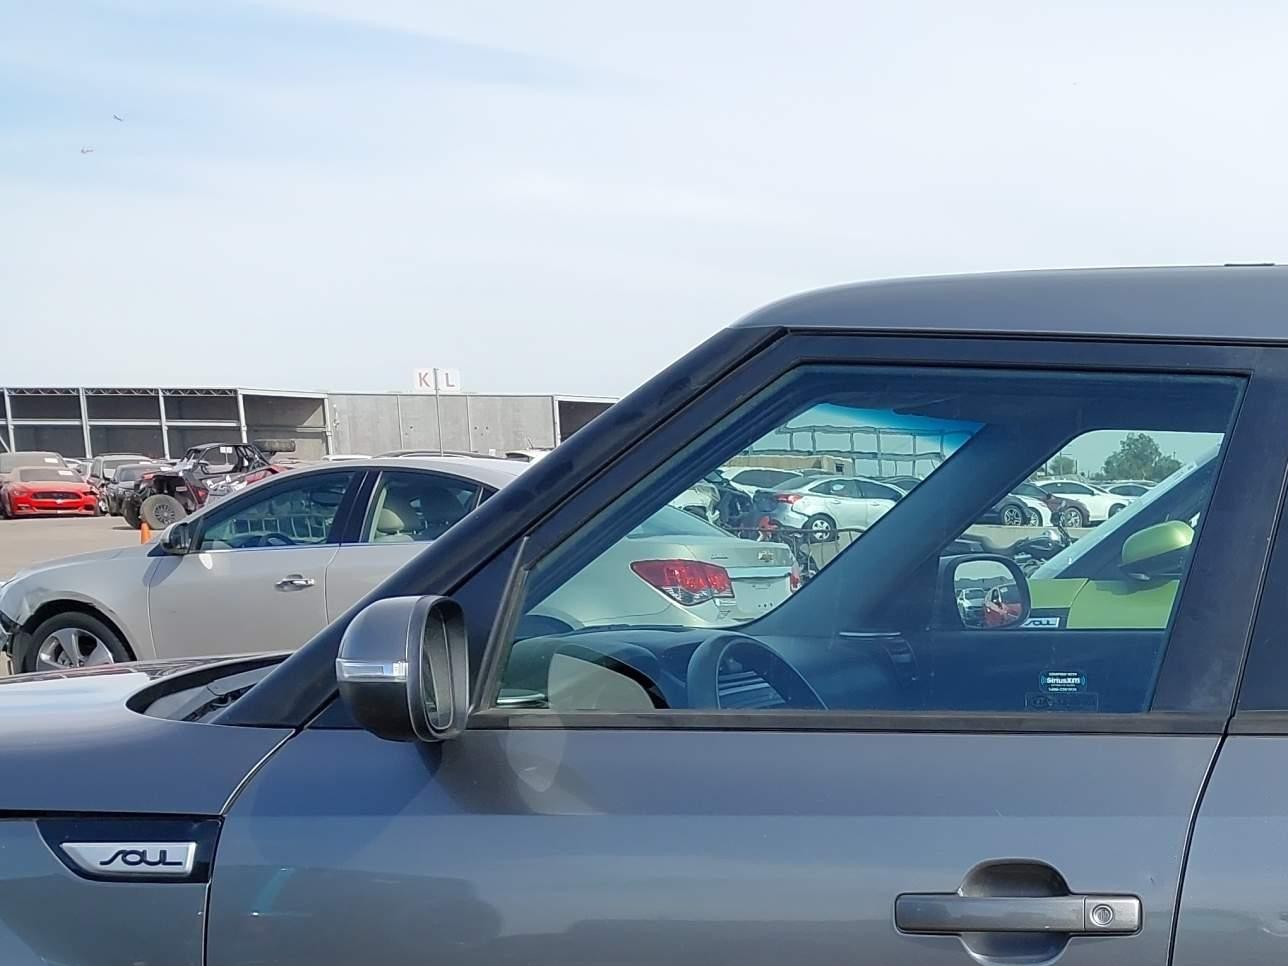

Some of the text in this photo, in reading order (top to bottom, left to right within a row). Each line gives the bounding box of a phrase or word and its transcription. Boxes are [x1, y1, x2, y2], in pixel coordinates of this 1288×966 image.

[418, 372, 431, 388] K
[445, 372, 456, 388] L
[99, 849, 183, 866] SOUL
